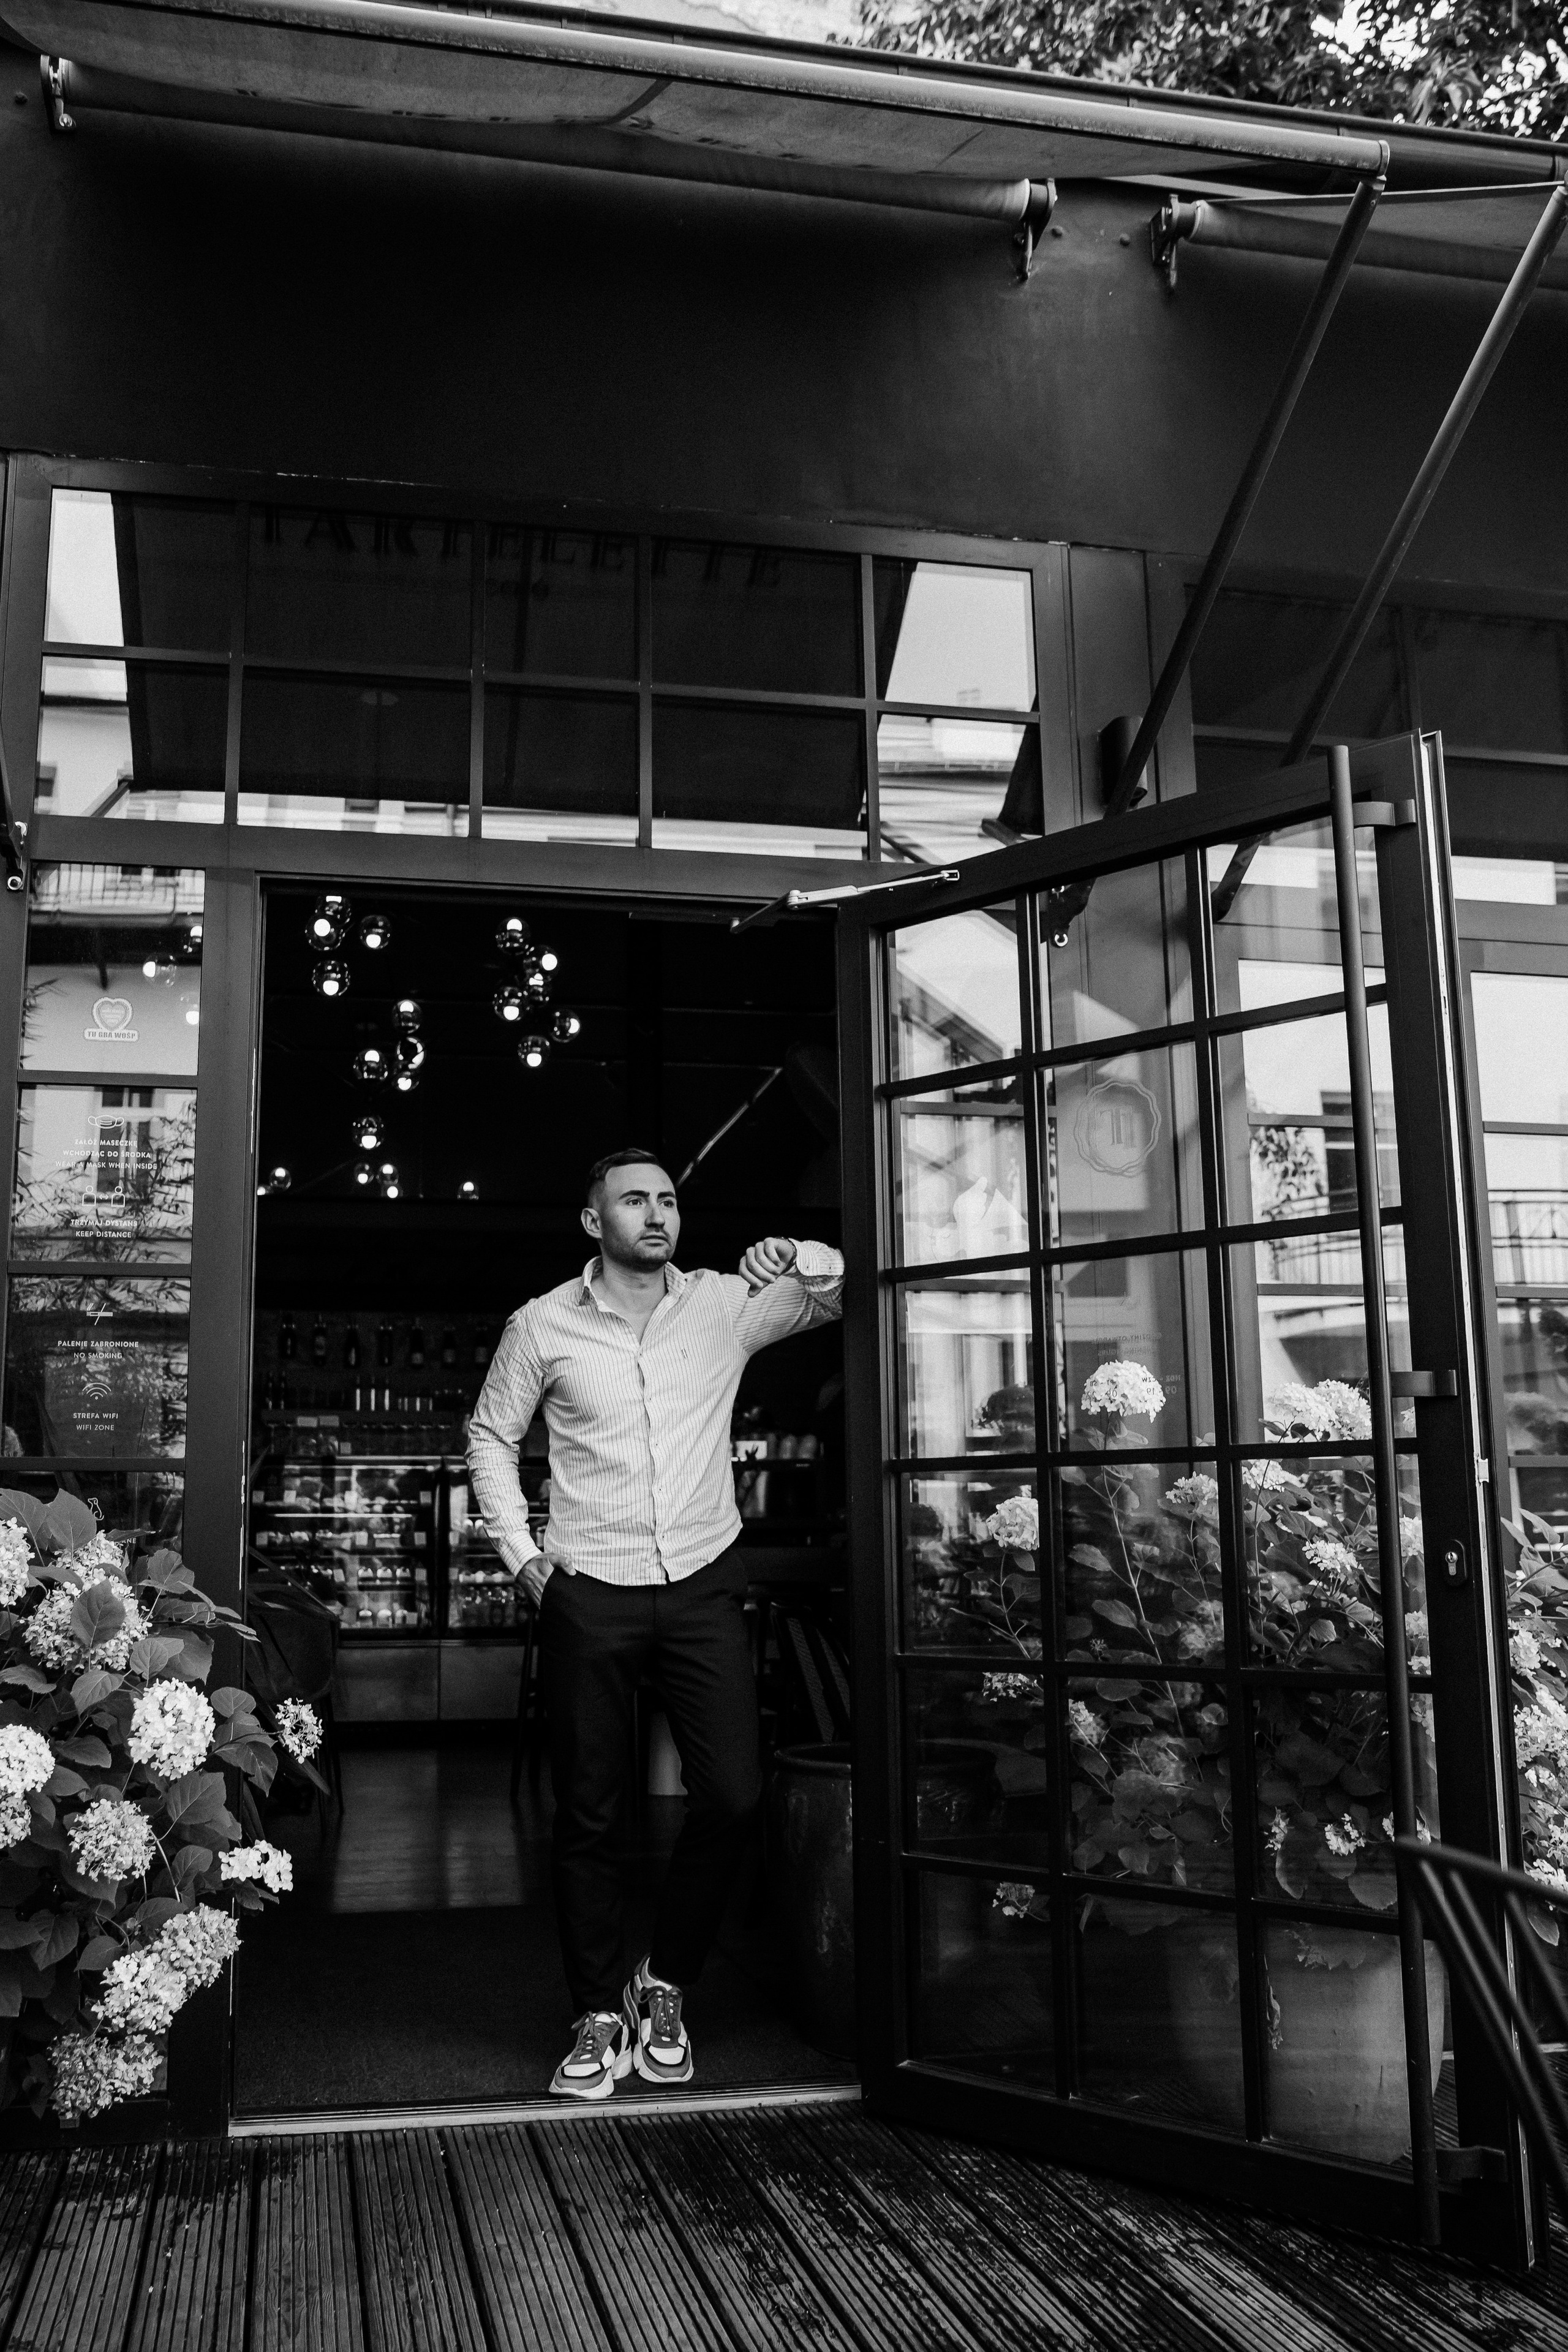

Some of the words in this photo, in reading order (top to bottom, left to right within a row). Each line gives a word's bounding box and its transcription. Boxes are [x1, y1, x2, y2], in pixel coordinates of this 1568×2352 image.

[75, 1137, 97, 1146] ZAŁÓŻ
[100, 1139, 138, 1148] MASECZKĘ
[63, 1150, 105, 1158] WCHODZĄC
[121, 1150, 151, 1158] ŚRODKA
